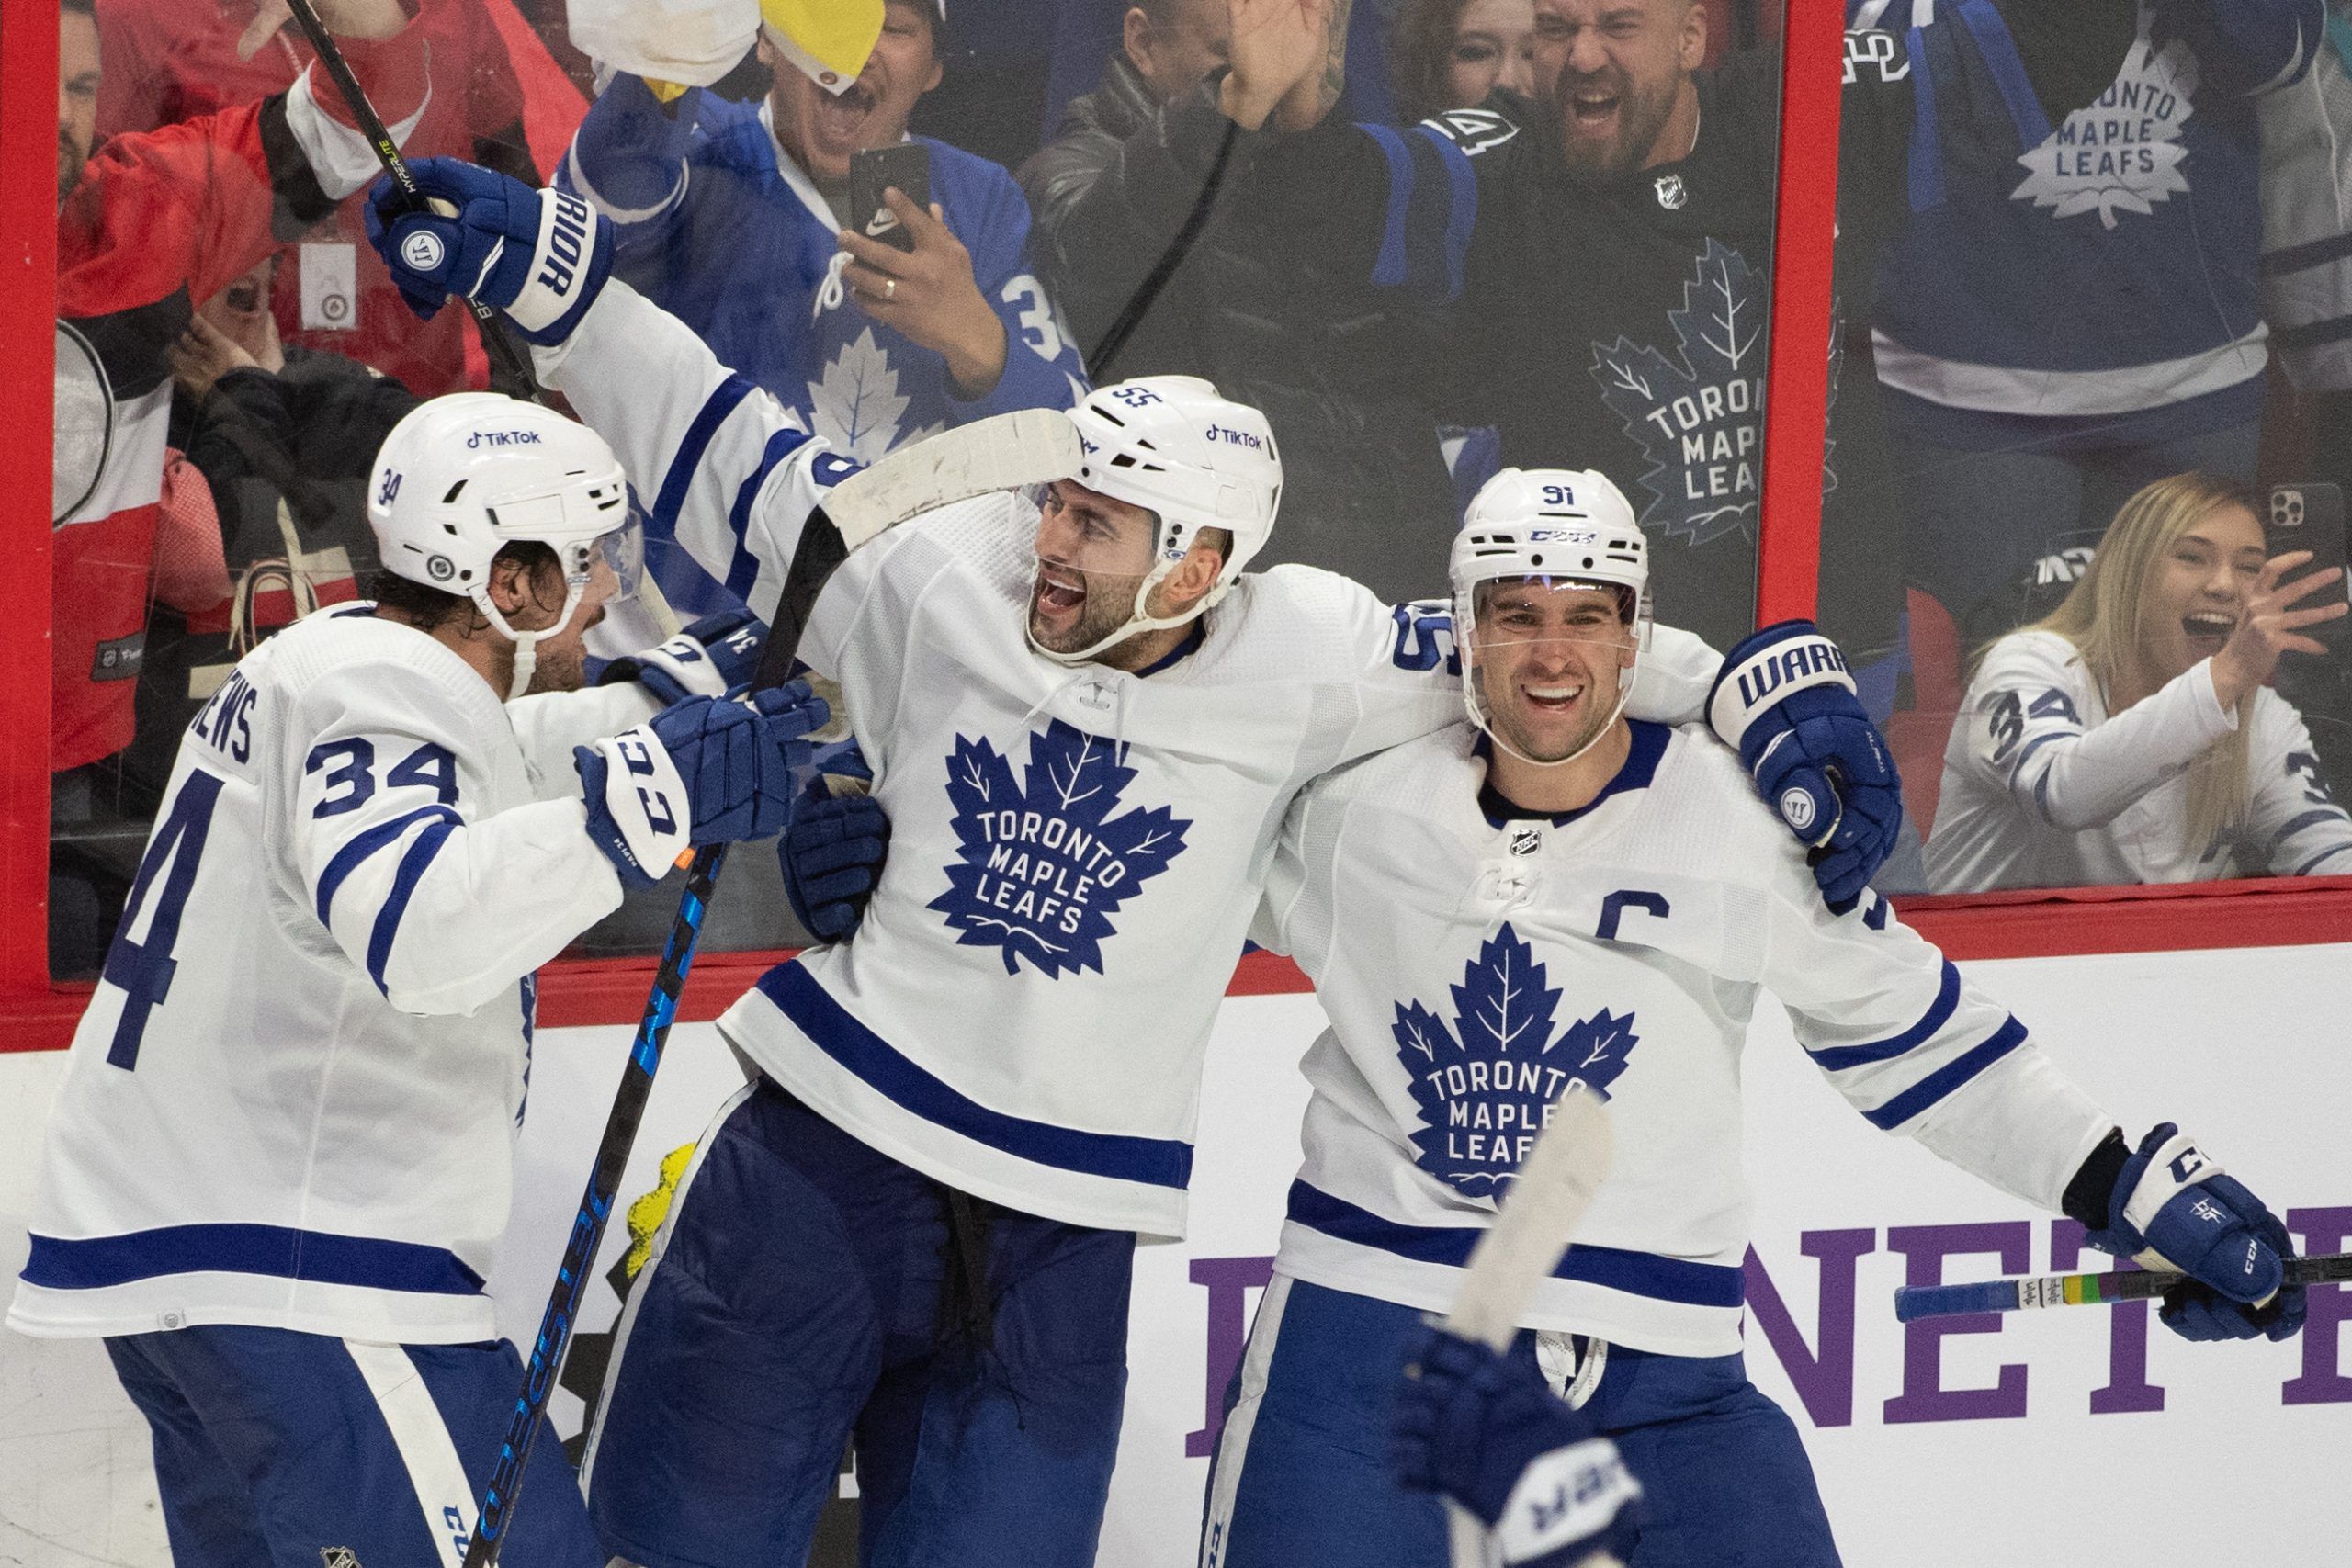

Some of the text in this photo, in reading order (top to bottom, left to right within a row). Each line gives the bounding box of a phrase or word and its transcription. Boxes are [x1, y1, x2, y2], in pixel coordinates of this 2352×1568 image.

[2091, 80, 2176, 121] ONTO
[2056, 118, 2154, 146] MAPLE
[379, 139, 416, 194] HYPERLITE
[2056, 148, 2154, 176] LEAFS
[1112, 386, 1163, 408] 55
[485, 430, 542, 446] TikTok
[1221, 428, 1262, 451] TikTok
[1681, 425, 1756, 465] MAP
[378, 468, 402, 506] 34
[1542, 485, 1575, 506] 91
[1685, 461, 1757, 501] LEA
[190, 668, 258, 765] EWS
[1977, 687, 2083, 764] 34
[305, 736, 461, 820] 34
[977, 810, 1126, 888] TORONTO
[987, 843, 1095, 904] MAPLE
[976, 874, 1083, 934] LEAFS
[1595, 889, 1670, 940] C
[1449, 1100, 1560, 1131] MAPLE
[1449, 1132, 1534, 1163] LEAF
[2245, 1238, 2258, 1275] CCM
[480, 1154, 614, 1542] JETSPEED
